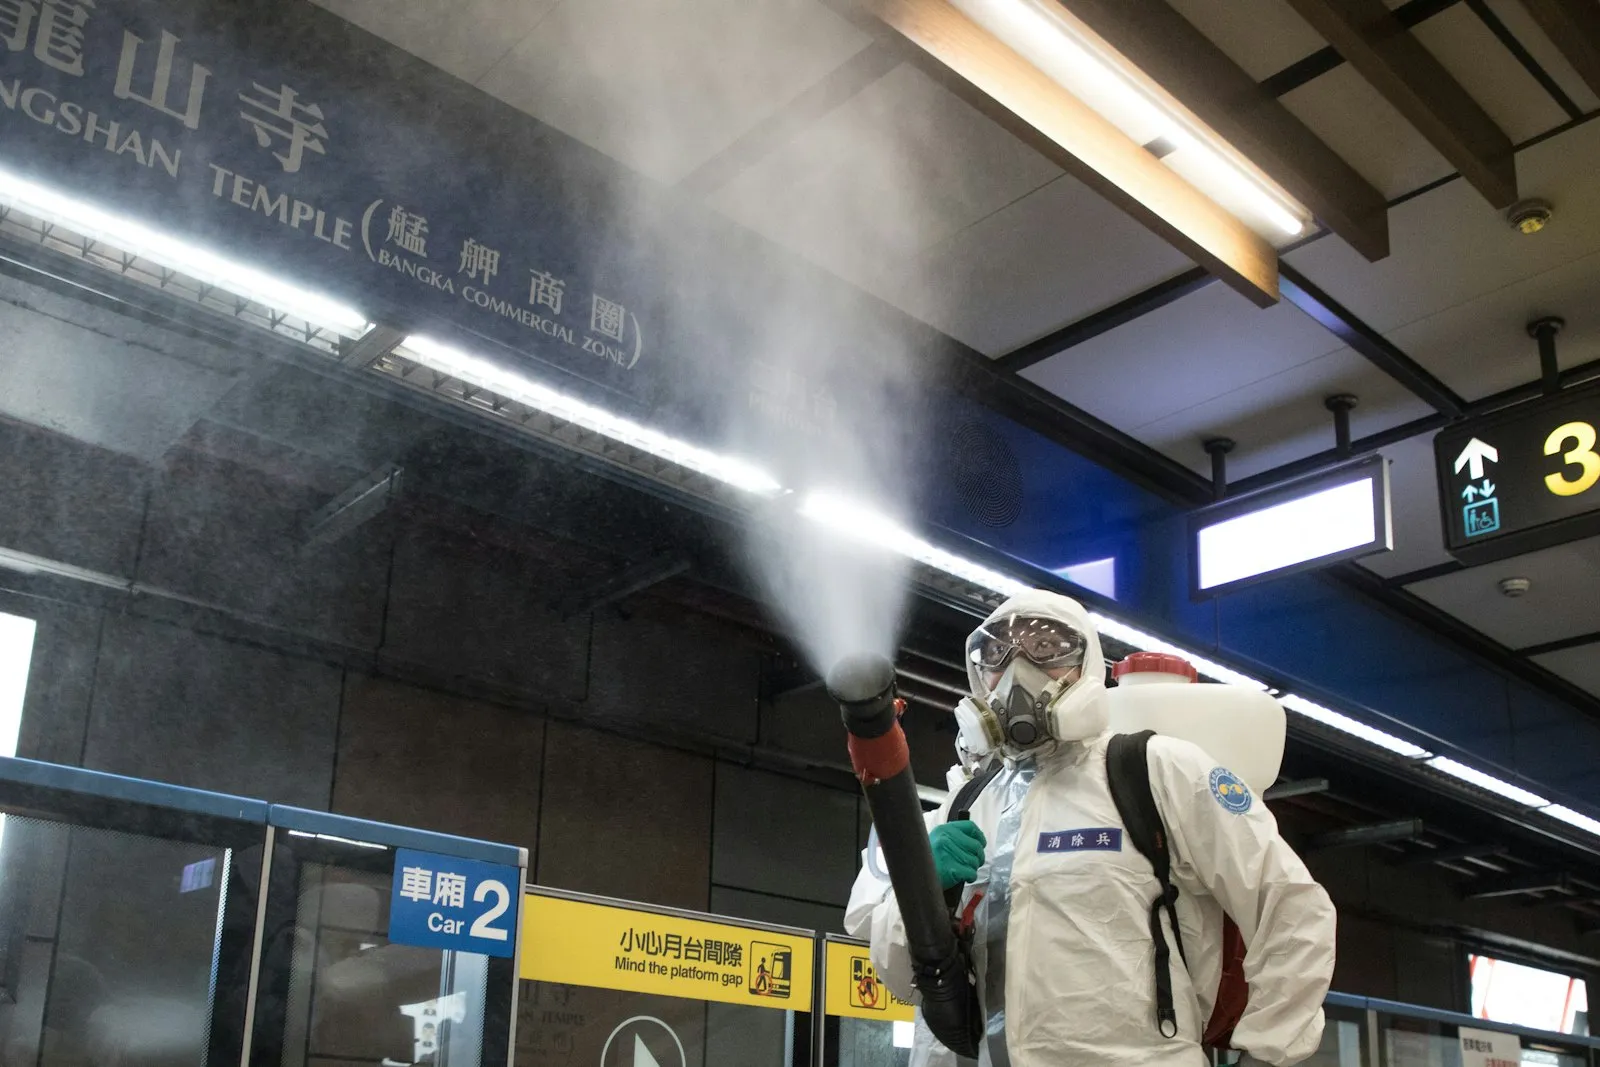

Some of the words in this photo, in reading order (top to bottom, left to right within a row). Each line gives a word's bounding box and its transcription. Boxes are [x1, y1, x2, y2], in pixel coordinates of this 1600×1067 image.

[209, 163, 353, 250] TEMPLE
[378, 249, 454, 295] BANGKA
[462, 286, 577, 347] COMMERCIAL
[581, 335, 626, 367] ZONE
[1544, 421, 1600, 497] 3
[1047, 832, 1111, 849] 消除兵
[400, 866, 467, 909] 車廂
[427, 912, 465, 935] Car
[469, 879, 511, 941] 2
[619, 927, 743, 968] 小心月台間隙
[614, 956, 646, 973] Mind
[648, 961, 668, 976] the
[670, 963, 719, 982] platform
[721, 973, 744, 987] gap
